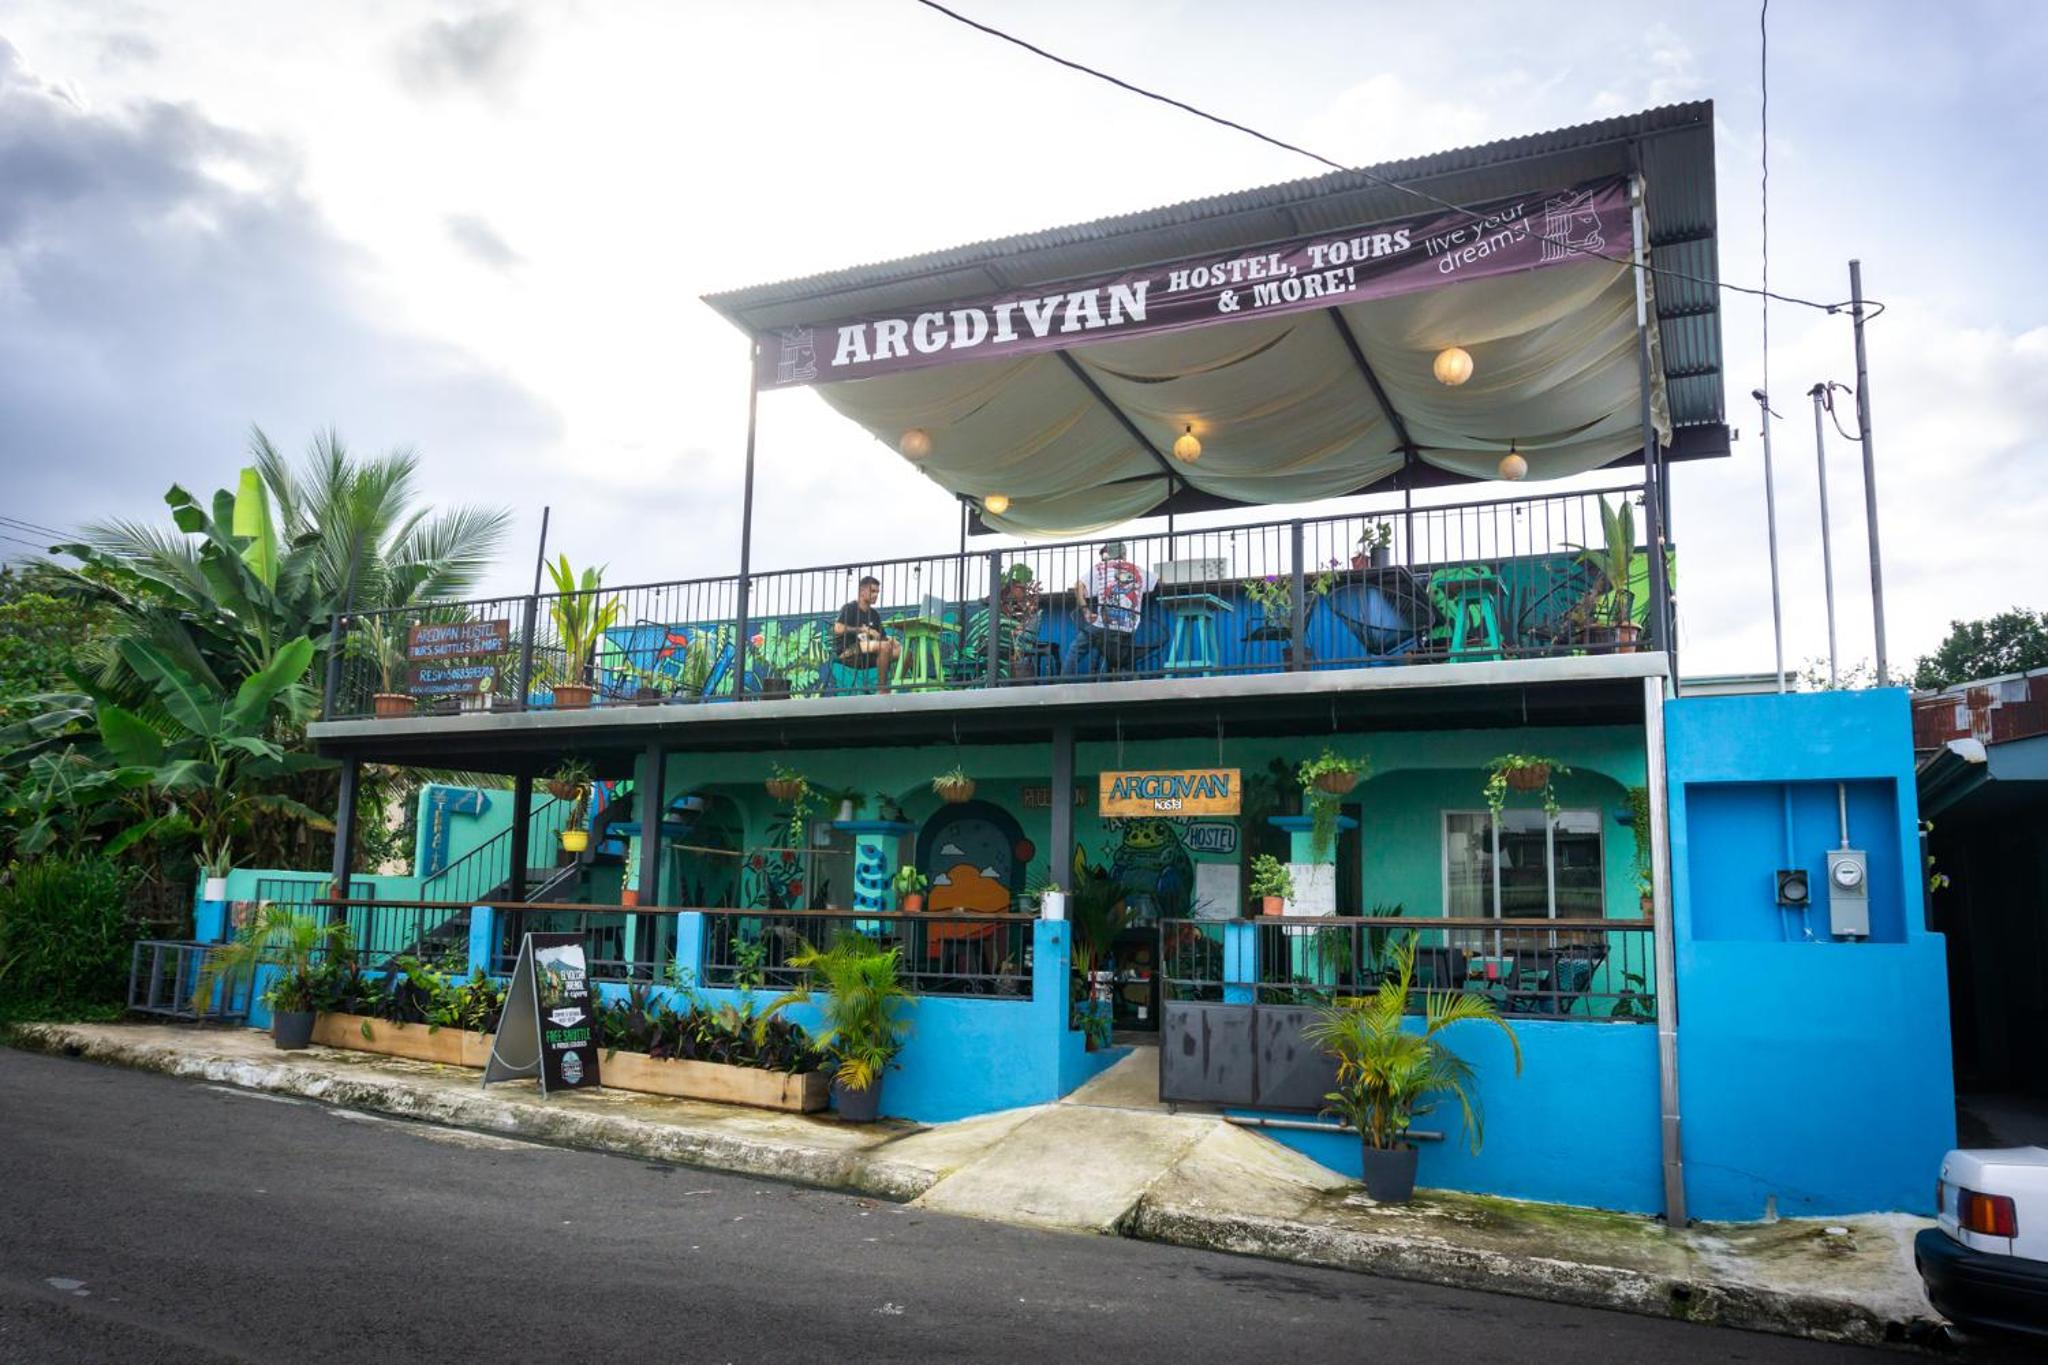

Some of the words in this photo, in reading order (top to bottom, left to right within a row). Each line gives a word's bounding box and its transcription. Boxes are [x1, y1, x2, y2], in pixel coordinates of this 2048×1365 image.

[1425, 229, 1465, 257] live
[1472, 202, 1525, 241] your
[1167, 253, 1297, 293] HOSTEL,
[1308, 228, 1411, 270] TOURS
[1217, 290, 1241, 313] &
[831, 280, 1150, 367] ARGDIVAN
[1109, 773, 1230, 799] ARGDIVAN
[1190, 827, 1233, 849] HOSTEL
